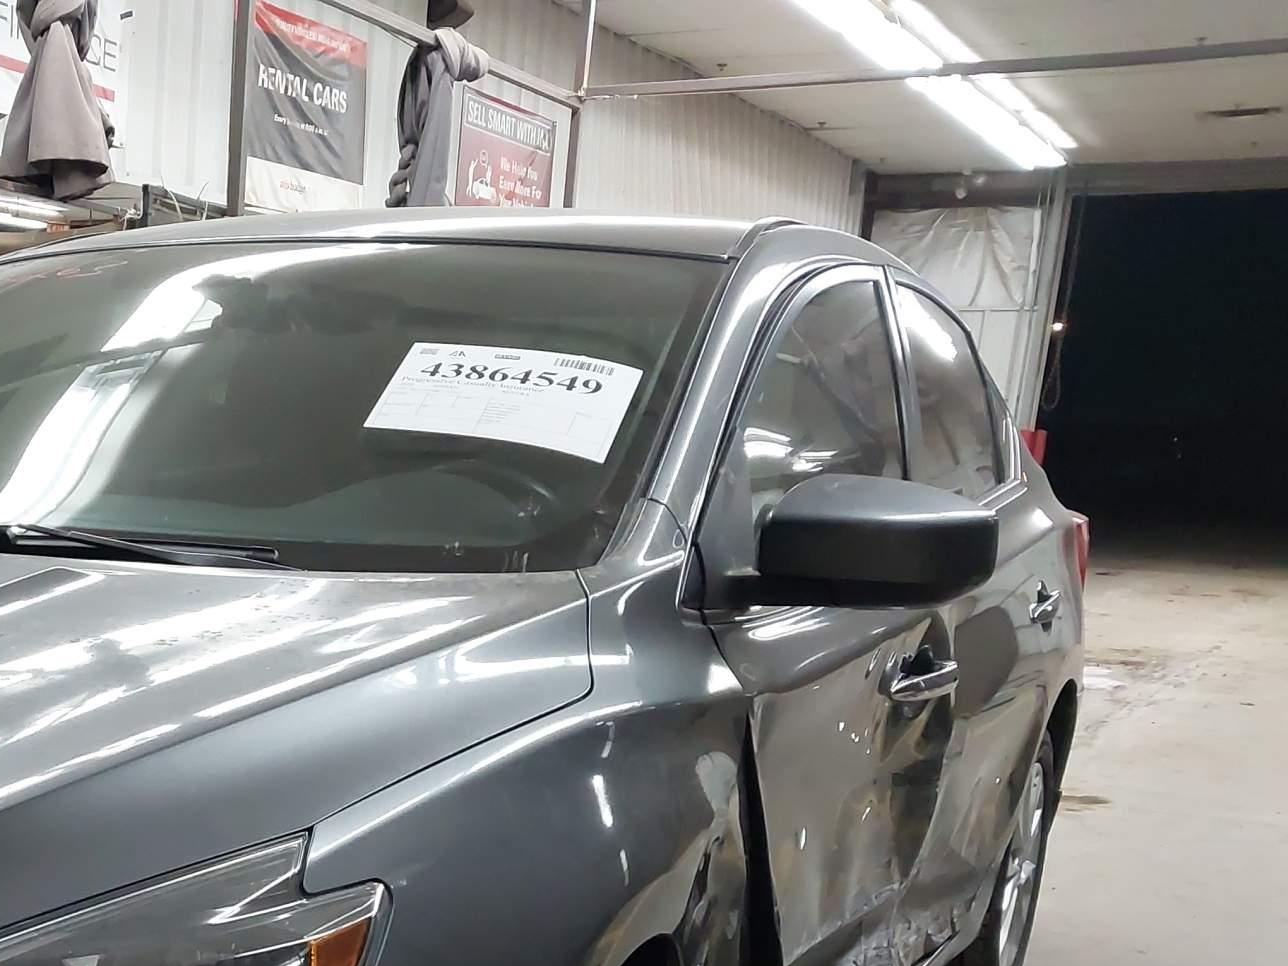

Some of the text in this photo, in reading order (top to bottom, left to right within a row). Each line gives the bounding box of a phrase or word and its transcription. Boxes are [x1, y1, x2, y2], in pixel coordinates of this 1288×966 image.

[258, 63, 348, 113] RENTAL CARS
[467, 100, 487, 127] SELL
[487, 108, 517, 138] SMART
[420, 361, 603, 395] 43864549
